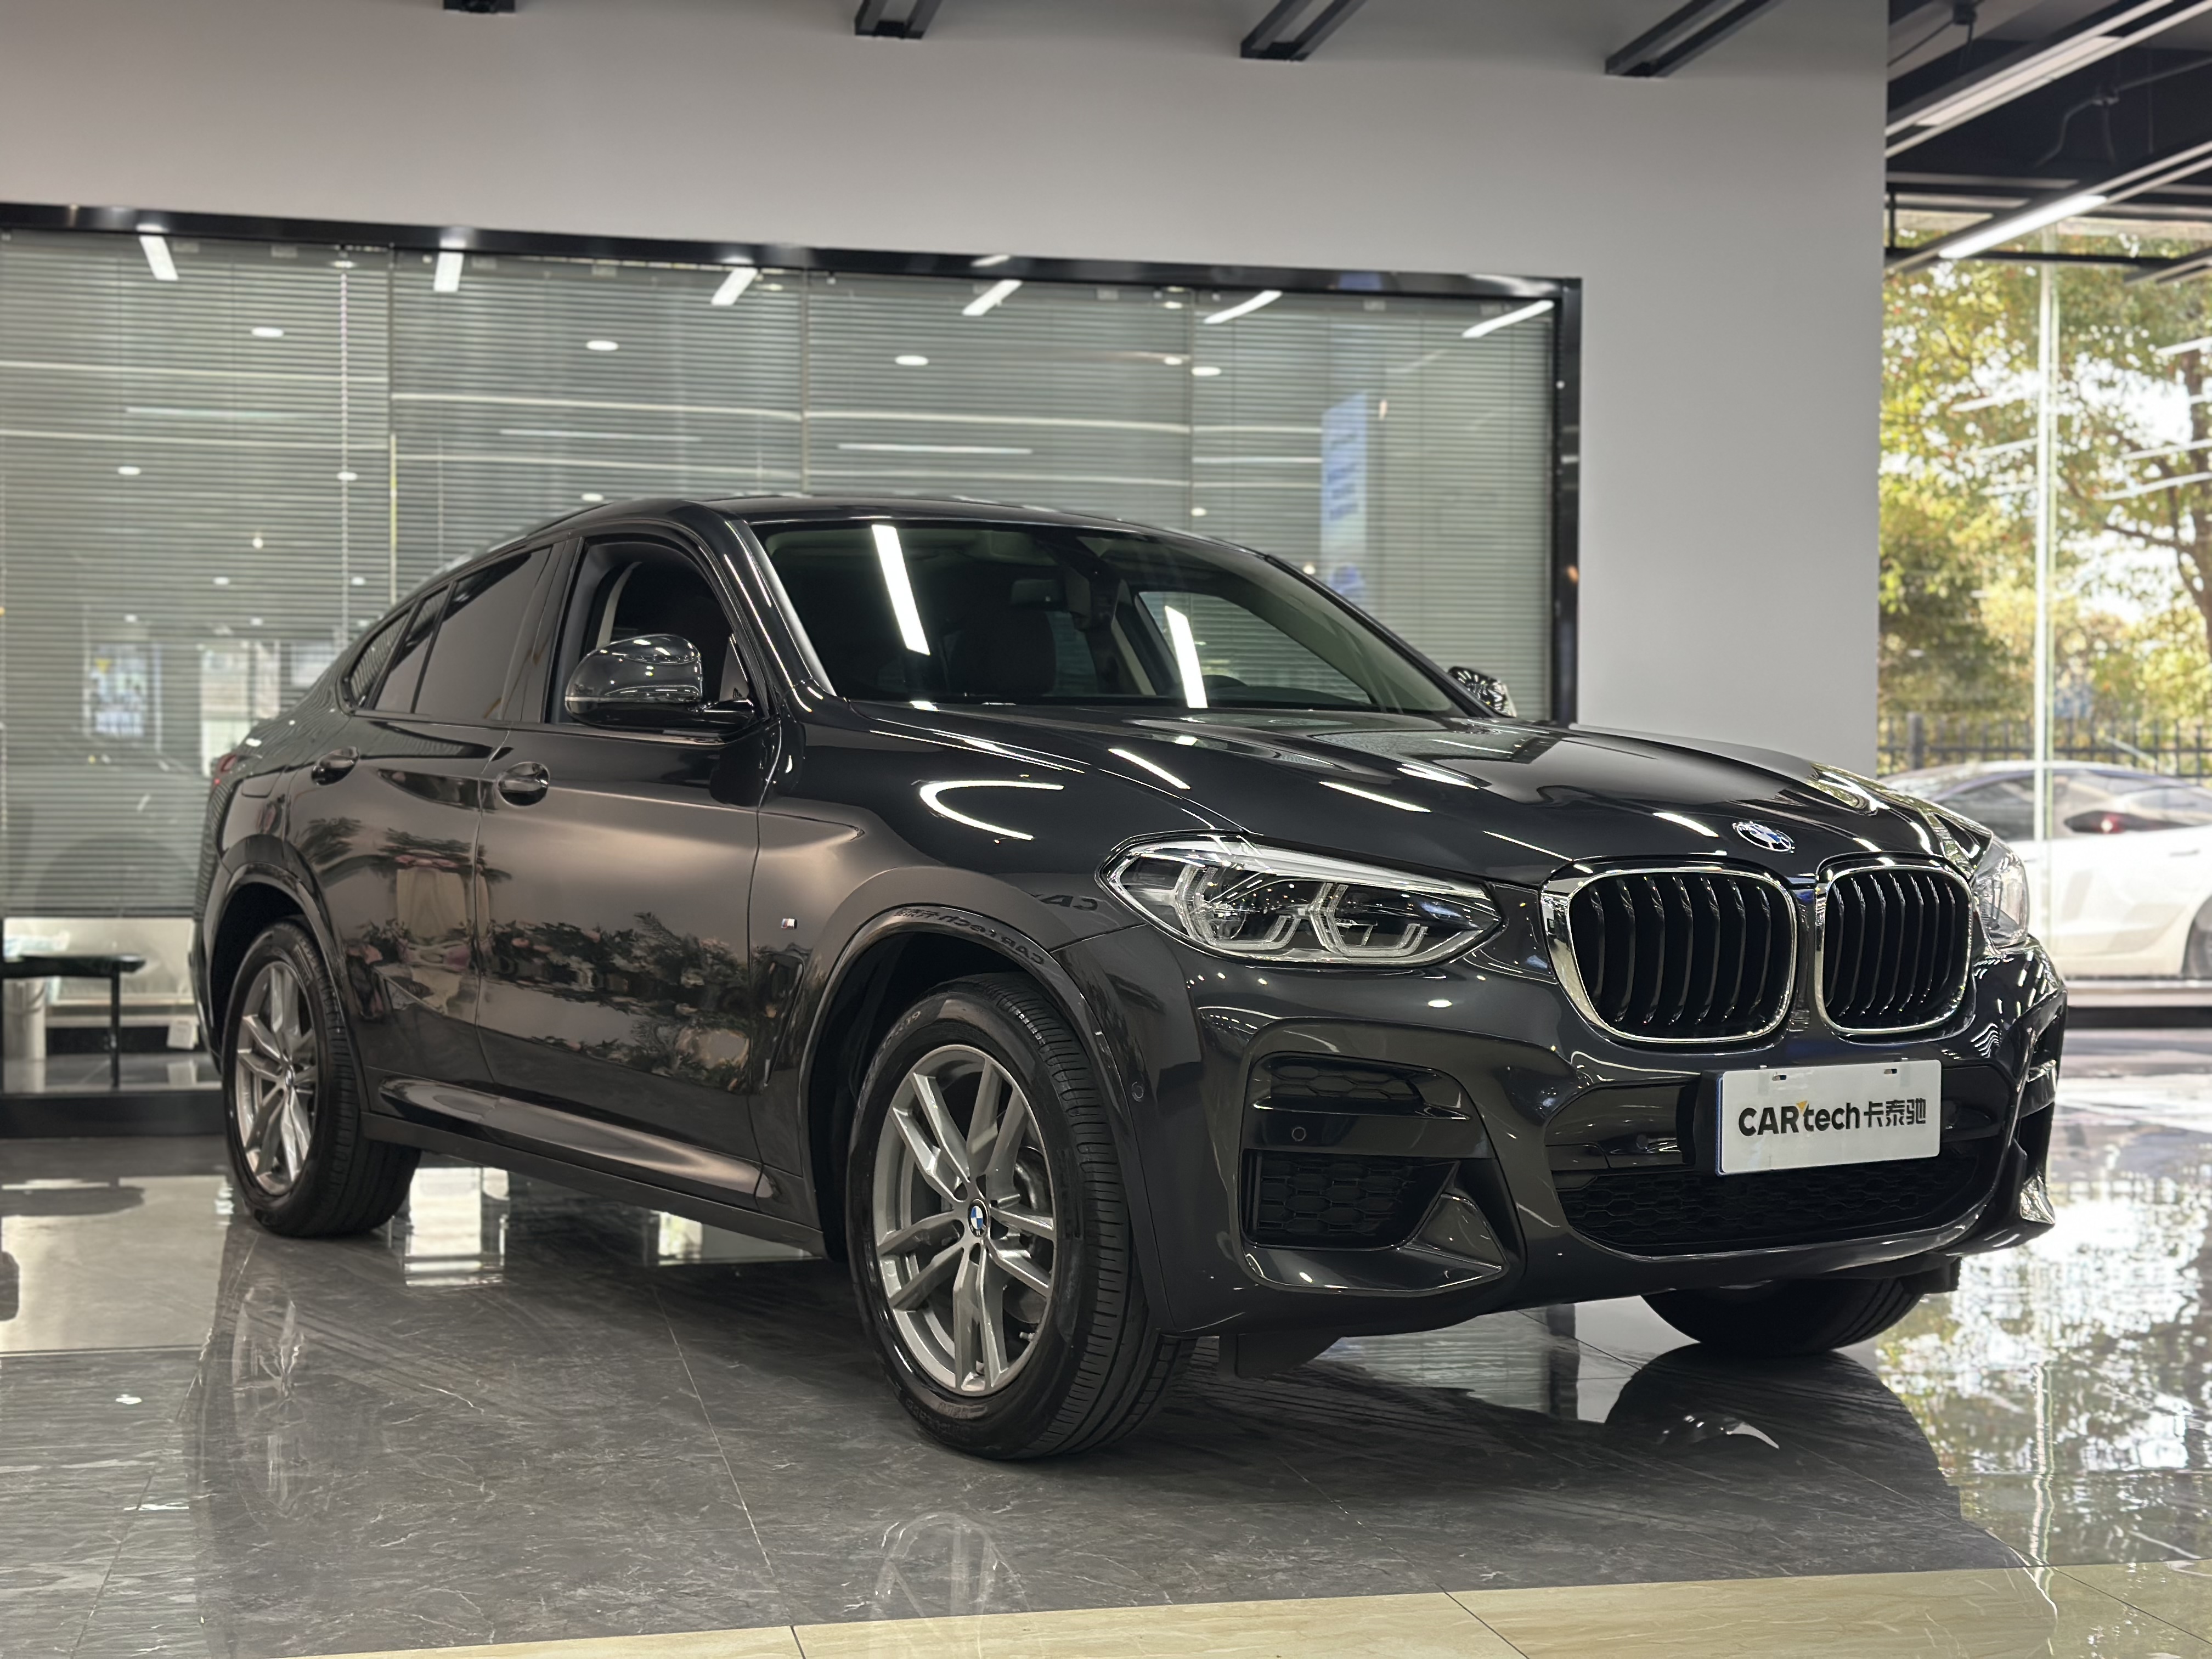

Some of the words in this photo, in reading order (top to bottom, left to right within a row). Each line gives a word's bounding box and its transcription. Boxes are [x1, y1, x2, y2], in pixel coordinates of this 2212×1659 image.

[1739, 1102, 1860, 1137] CARtech
[1864, 1098, 1926, 1127] 卡泰驰
